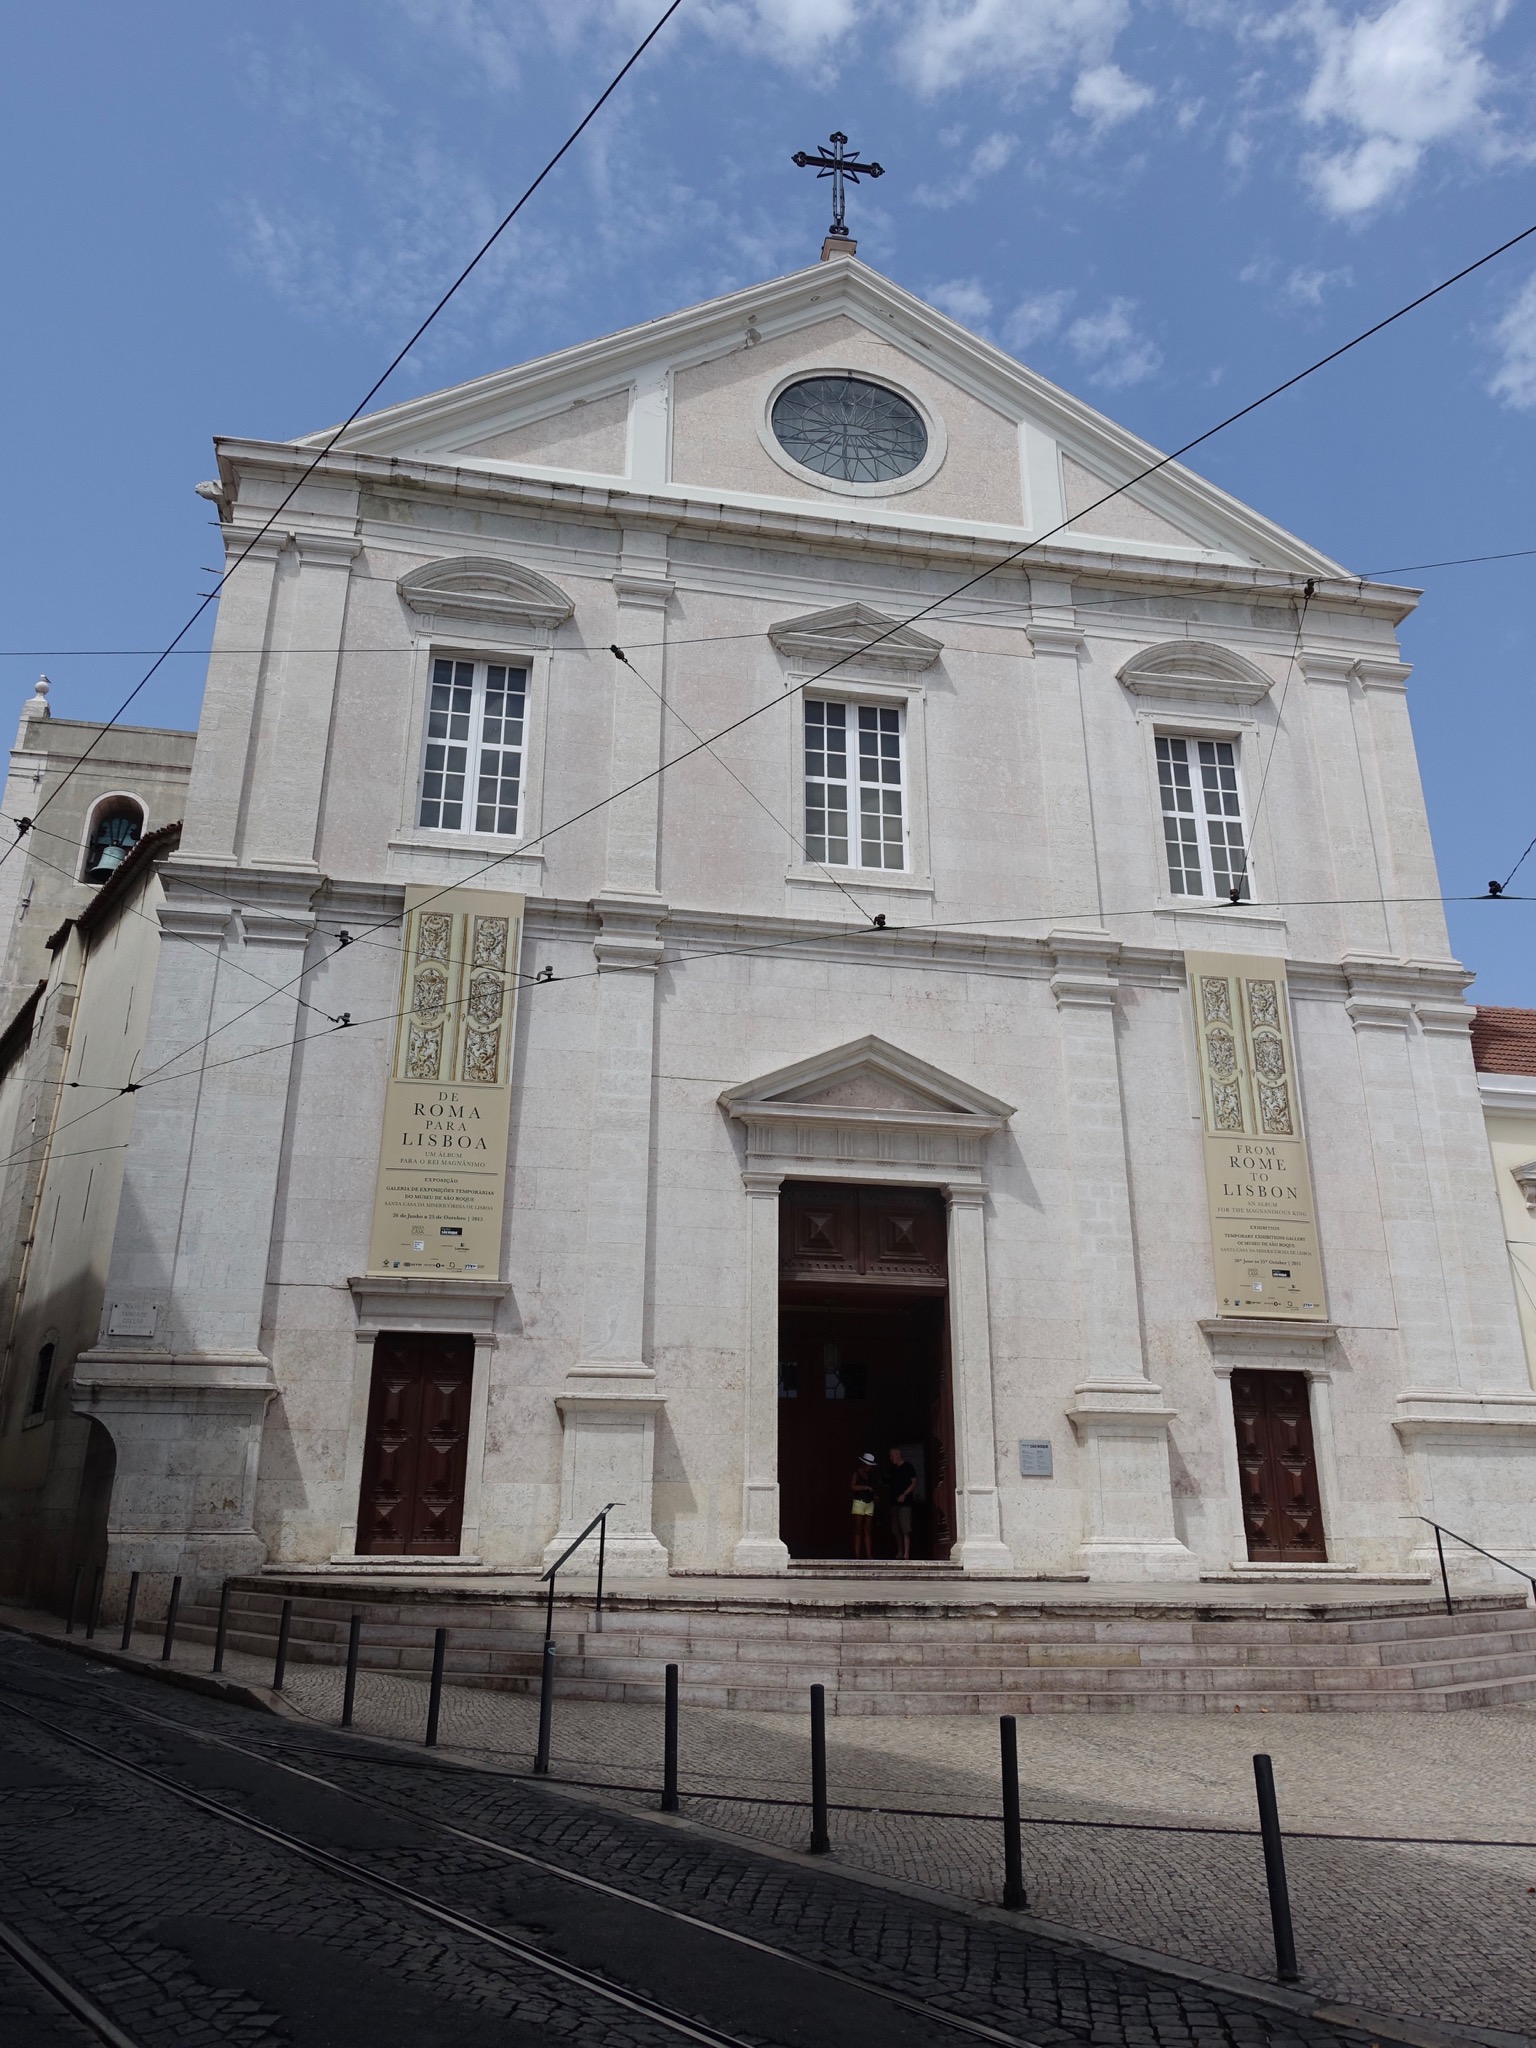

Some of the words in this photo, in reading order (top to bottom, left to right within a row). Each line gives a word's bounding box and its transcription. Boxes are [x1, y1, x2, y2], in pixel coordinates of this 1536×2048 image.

[439, 1092, 458, 1101] DE
[413, 1103, 480, 1119] ROMA
[426, 1120, 466, 1131] PARA
[402, 1133, 487, 1149] LISBOA
[1237, 1145, 1275, 1155] FROM
[1229, 1156, 1286, 1171] ROME
[1250, 1173, 1268, 1182] TO
[1224, 1184, 1297, 1199] LISBON
